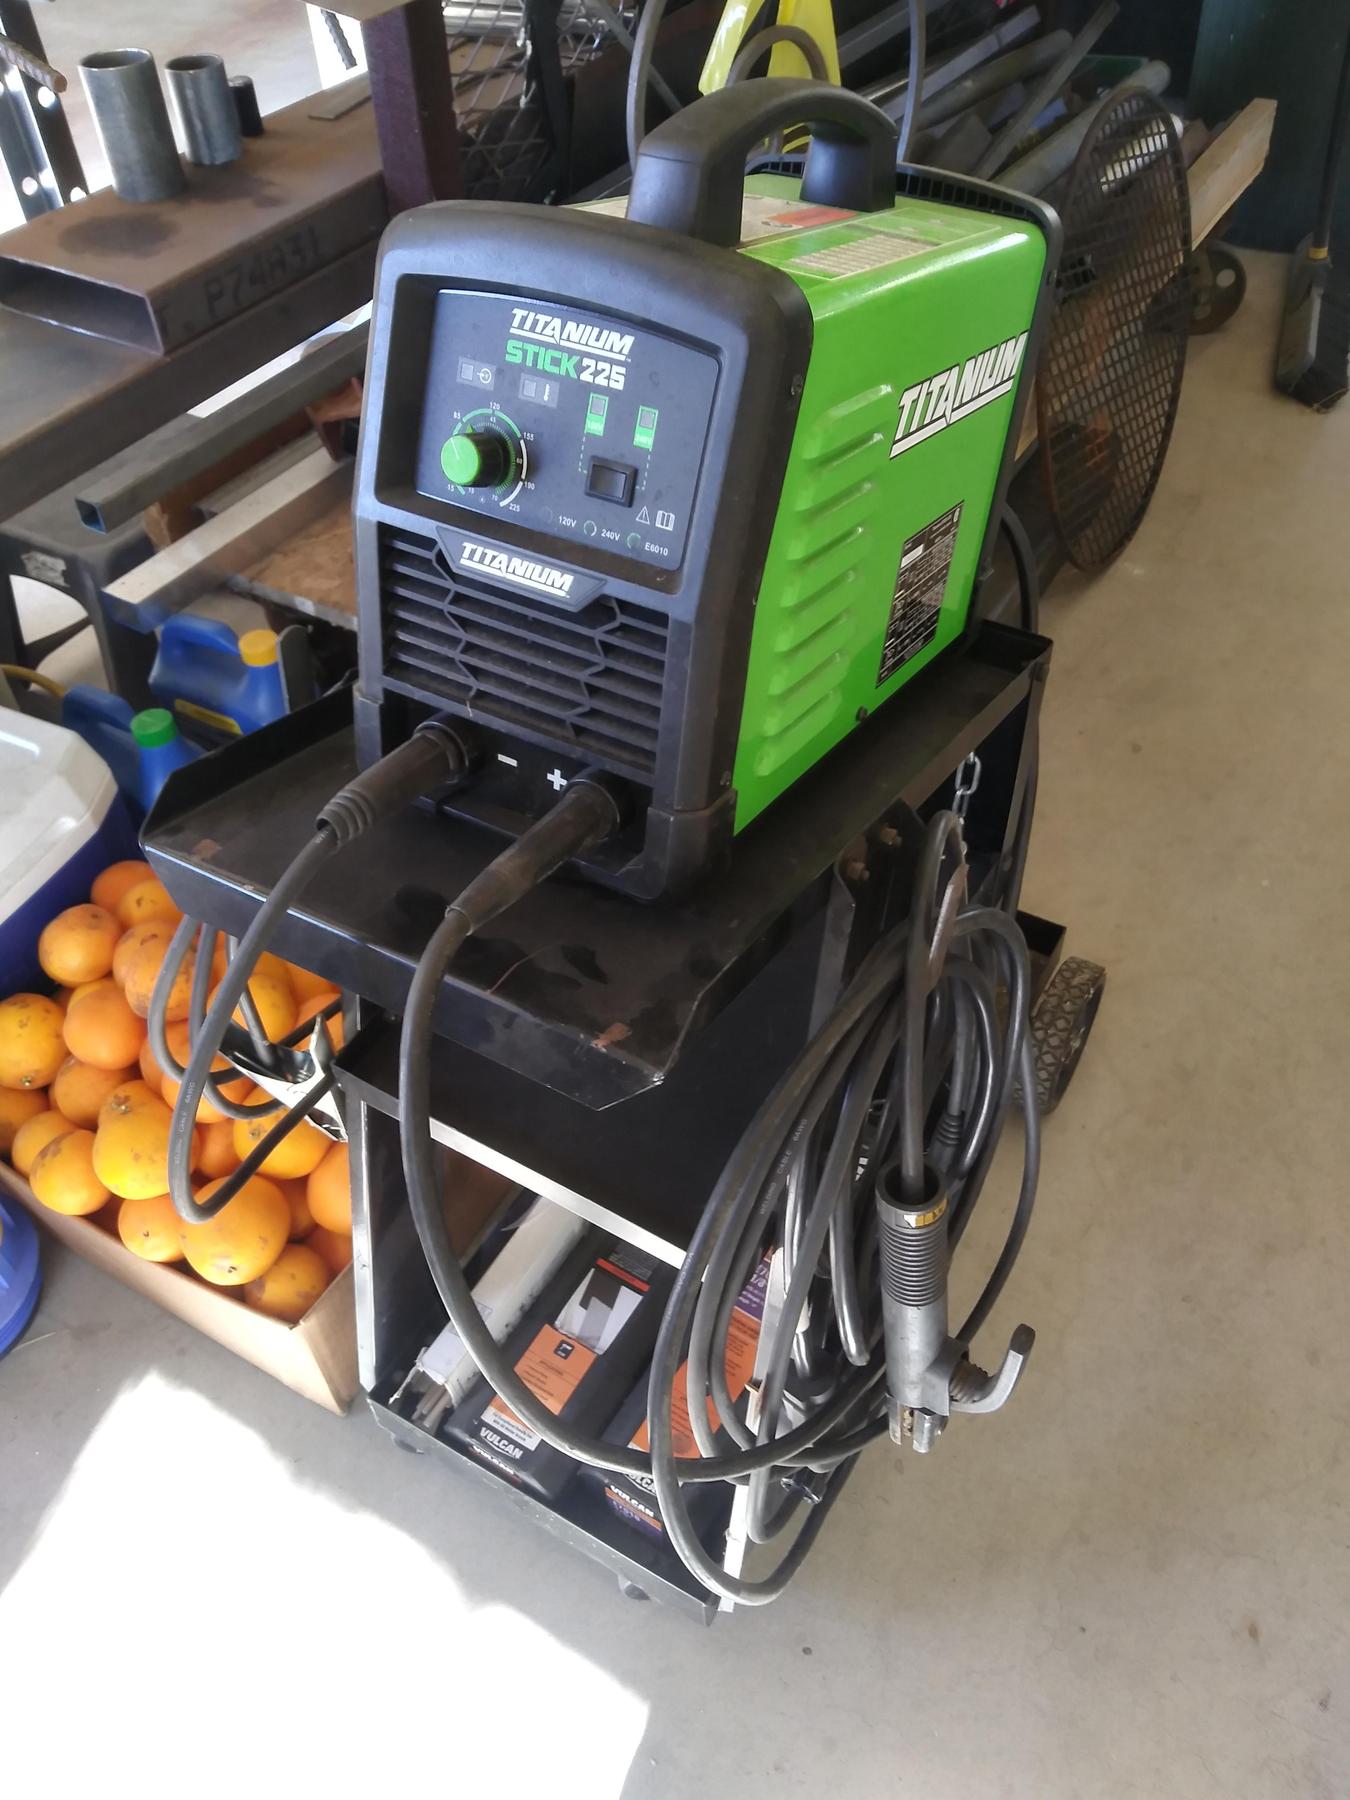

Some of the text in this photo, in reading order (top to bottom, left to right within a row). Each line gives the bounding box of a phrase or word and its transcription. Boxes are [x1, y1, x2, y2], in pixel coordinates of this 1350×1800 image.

[510, 308, 635, 359] TITANIUM
[505, 339, 627, 391] STICK 225
[891, 330, 1030, 455] TITANIUM
[558, 515, 577, 528] 120V
[601, 528, 620, 541] 240V
[460, 541, 574, 594] TITANIUM
[644, 541, 669, 556] E6010
[479, 1426, 524, 1460] VULCAN
